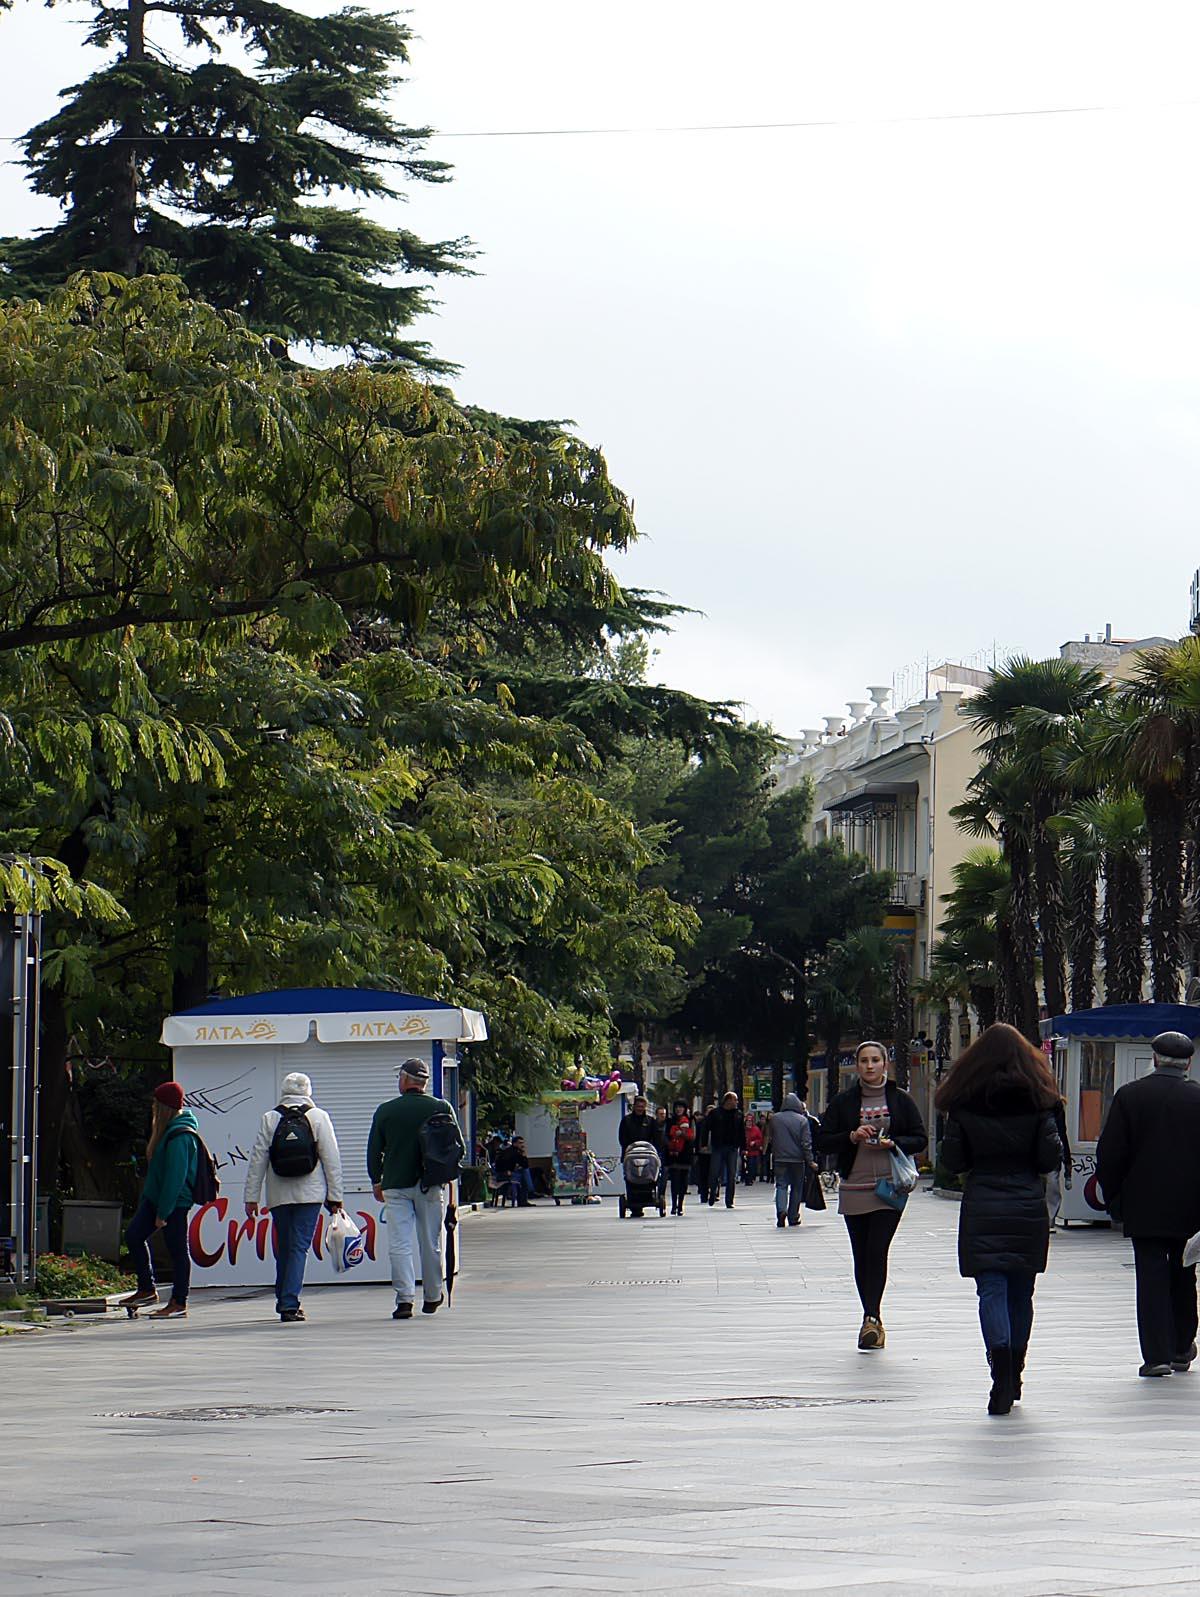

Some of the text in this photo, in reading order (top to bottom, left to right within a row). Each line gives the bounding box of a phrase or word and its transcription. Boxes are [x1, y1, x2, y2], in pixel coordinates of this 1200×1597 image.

[195, 1025, 244, 1040] ЯЛТА
[349, 1022, 399, 1037] ЯЛТА
[188, 1197, 376, 1268] Cria
